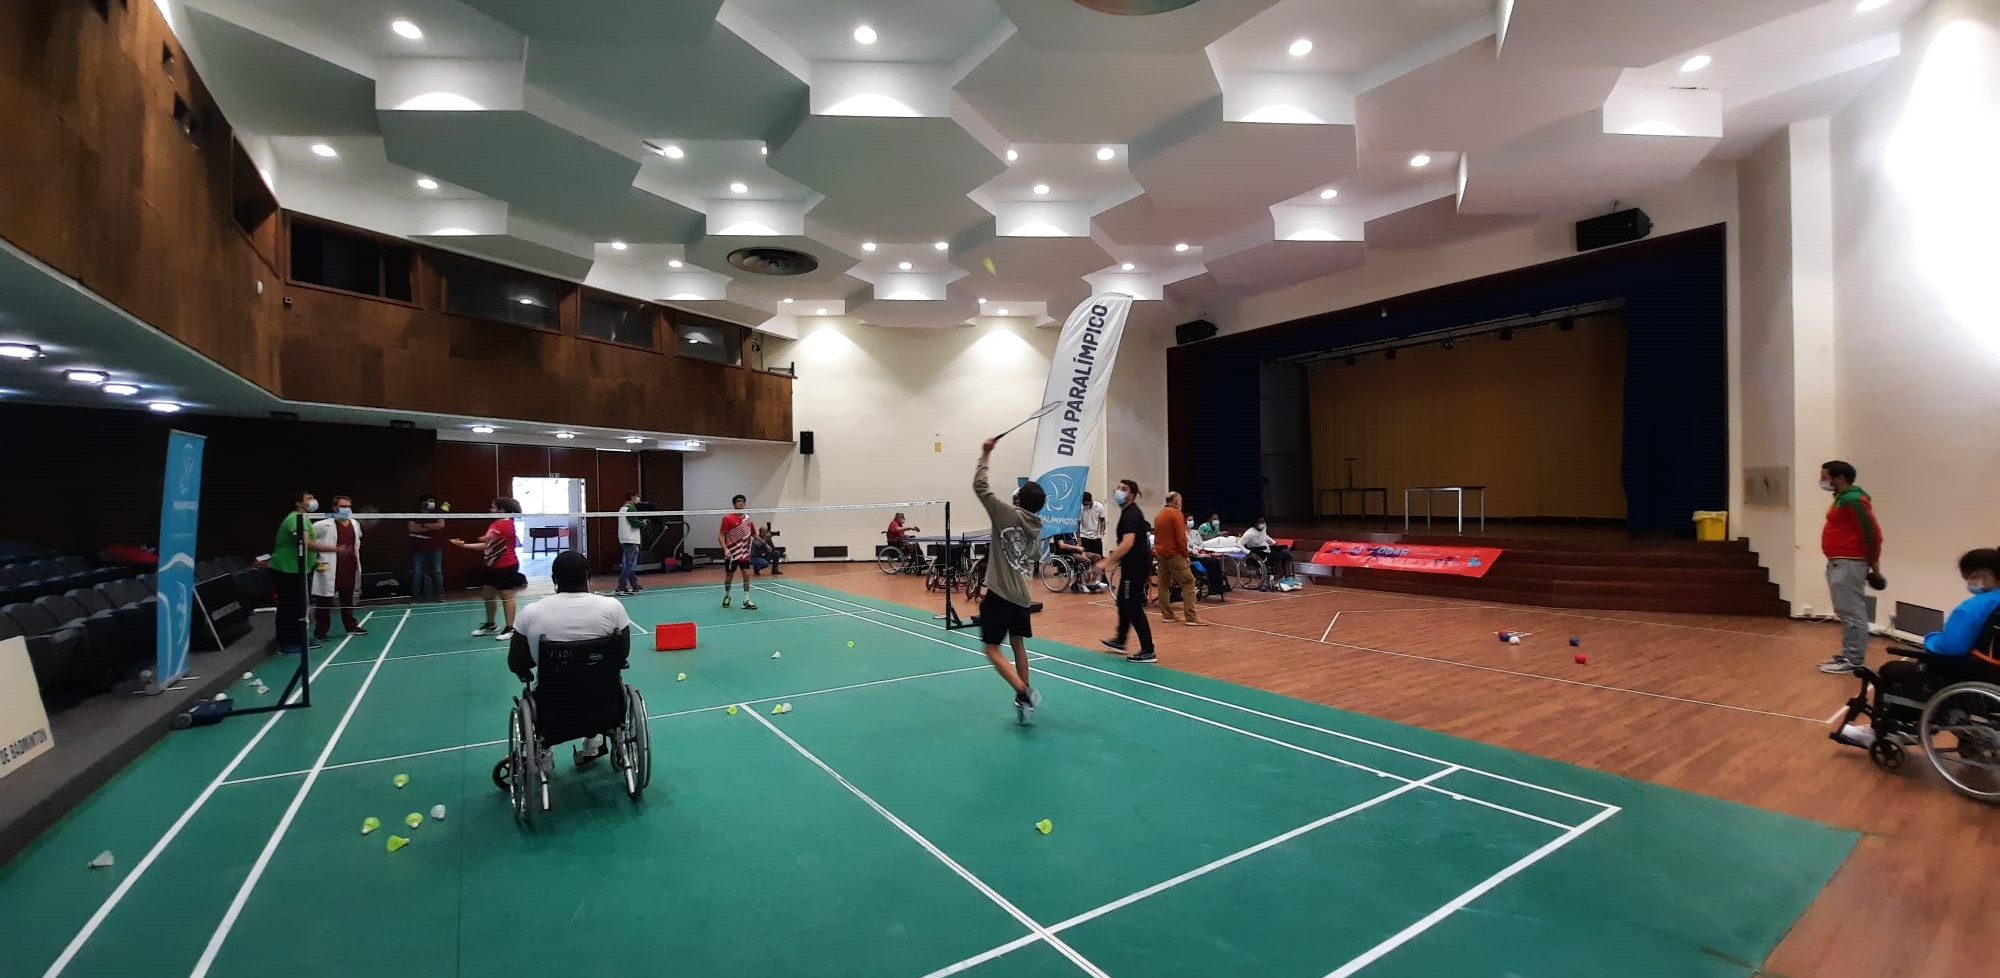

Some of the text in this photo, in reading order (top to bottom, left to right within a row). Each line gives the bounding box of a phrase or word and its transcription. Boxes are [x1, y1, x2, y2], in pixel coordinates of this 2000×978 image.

[1057, 304, 1108, 456] DIA PARALÍMPICO
[9, 726, 48, 760] BADMINTON
